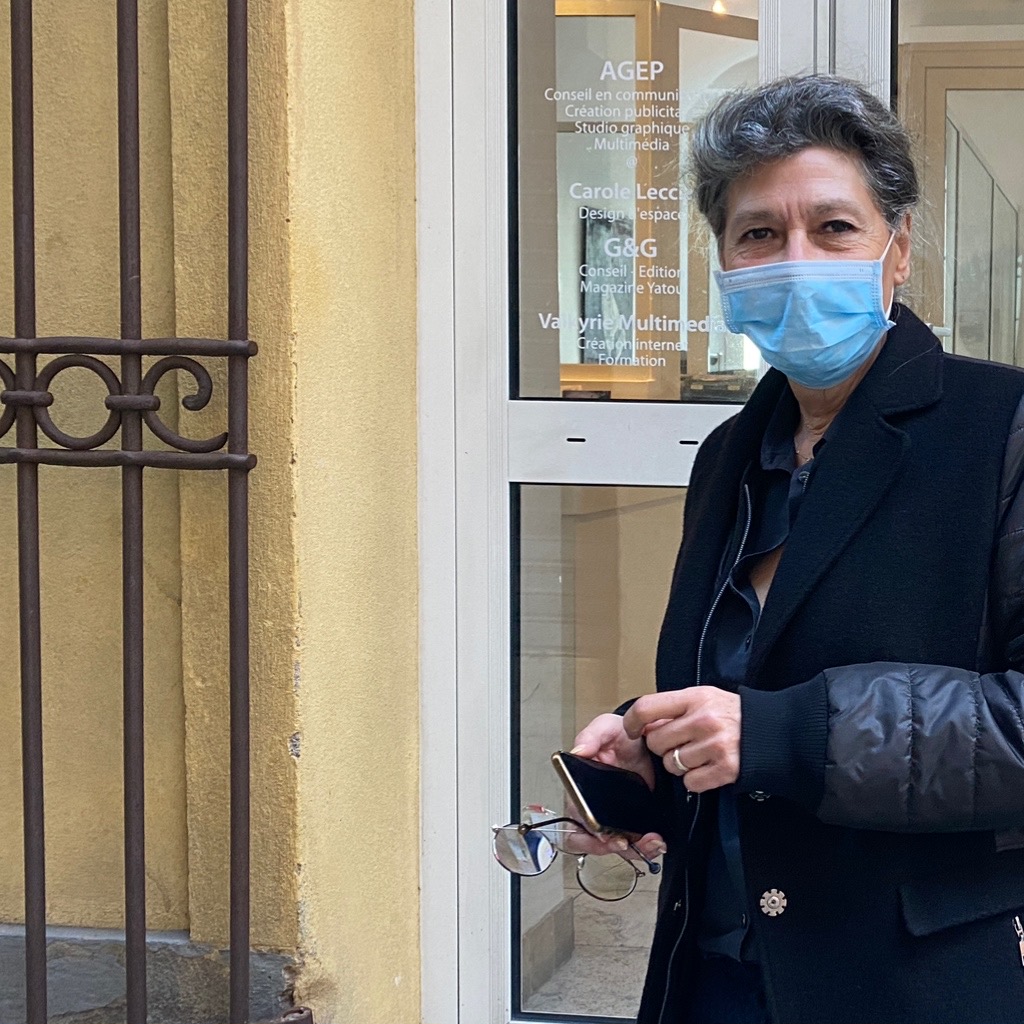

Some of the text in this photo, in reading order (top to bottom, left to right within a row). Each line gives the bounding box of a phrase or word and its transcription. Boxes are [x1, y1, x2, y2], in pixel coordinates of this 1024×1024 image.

[599, 60, 665, 81] AGEP
[544, 87, 680, 101] Conseil en communi
[564, 104, 681, 122] Création publicita
[574, 120, 691, 137] Studio graphique
[593, 137, 670, 151] Multimédia
[568, 182, 631, 200] Carole
[578, 206, 625, 223] Design
[603, 237, 658, 258] G&G
[578, 263, 628, 278] Conseil
[579, 280, 644, 297] Magazine
[538, 312, 614, 335] Vayrie
[576, 336, 632, 351] Création
[598, 353, 667, 367] Formation
